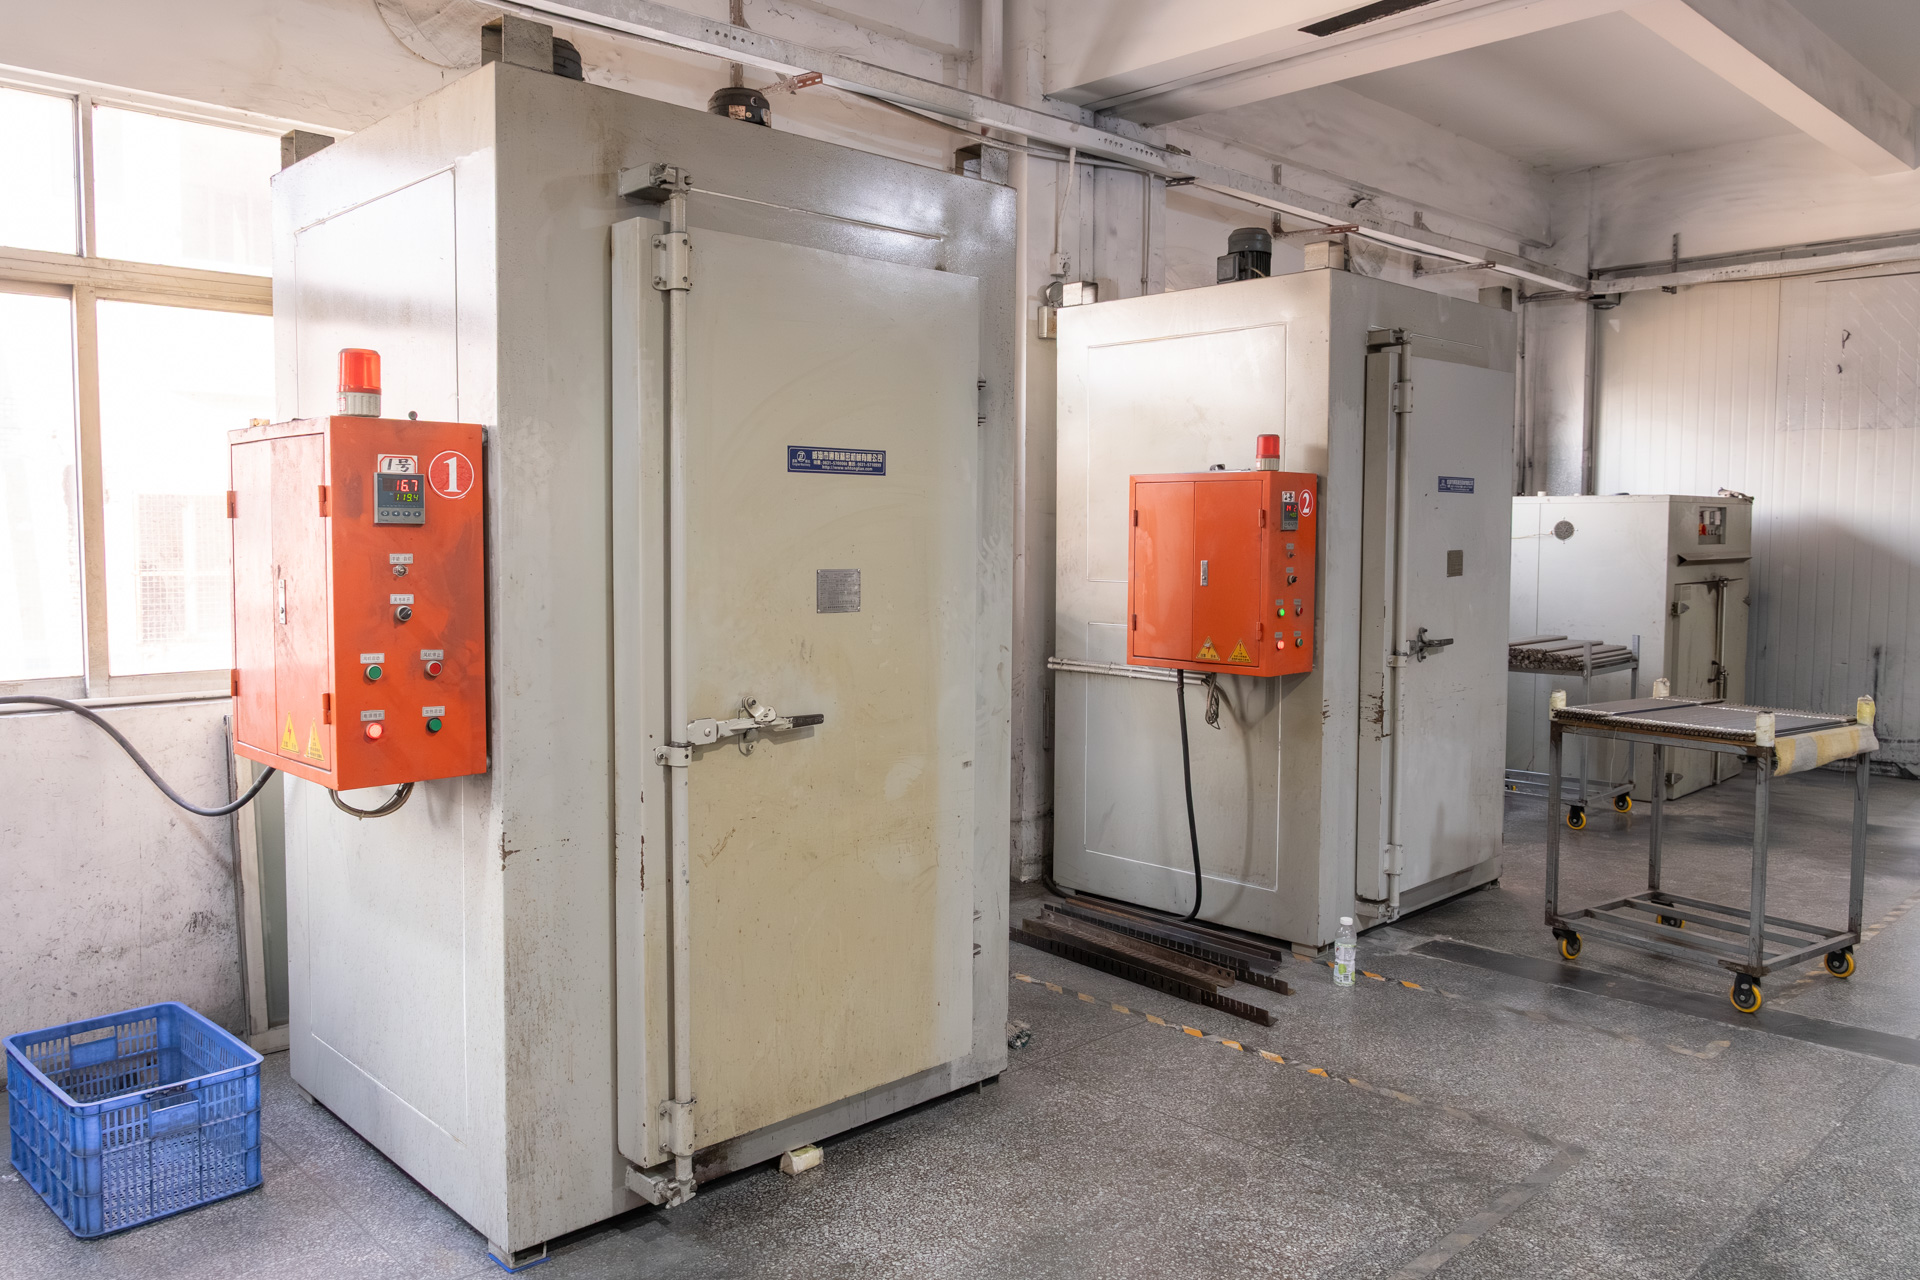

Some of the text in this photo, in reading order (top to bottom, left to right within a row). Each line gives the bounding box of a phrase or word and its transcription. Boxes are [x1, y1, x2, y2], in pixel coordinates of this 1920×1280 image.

[387, 458, 411, 472] 1号
[443, 457, 462, 492] 1
[1303, 493, 1310, 513] 2
